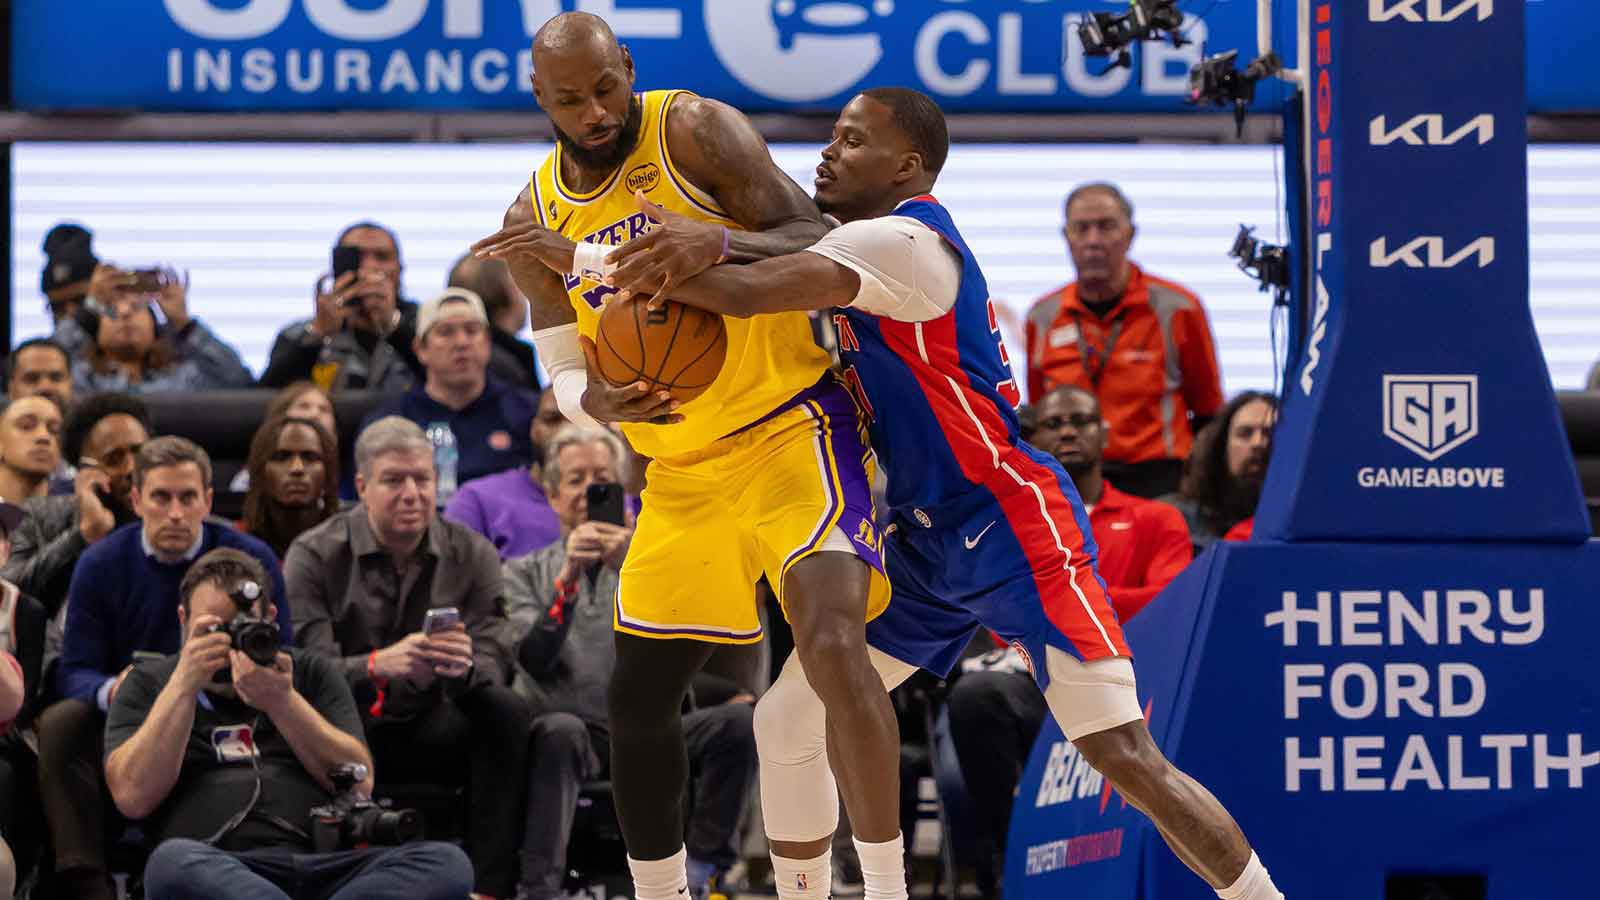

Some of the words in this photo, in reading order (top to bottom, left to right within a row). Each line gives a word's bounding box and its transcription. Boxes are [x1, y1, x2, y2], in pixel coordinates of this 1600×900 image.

[914, 11, 1208, 97] CLUB
[1369, 114, 1494, 145] KIA
[628, 169, 658, 187] bibigo
[1369, 236, 1495, 268] KIA
[1301, 231, 1332, 397] LAW
[1392, 383, 1469, 449] GA
[1358, 467, 1504, 487] GAMEABOVE
[1264, 589, 1544, 646] HENRY
[1284, 663, 1486, 719] FORD
[1285, 734, 1600, 791] HEALTH
